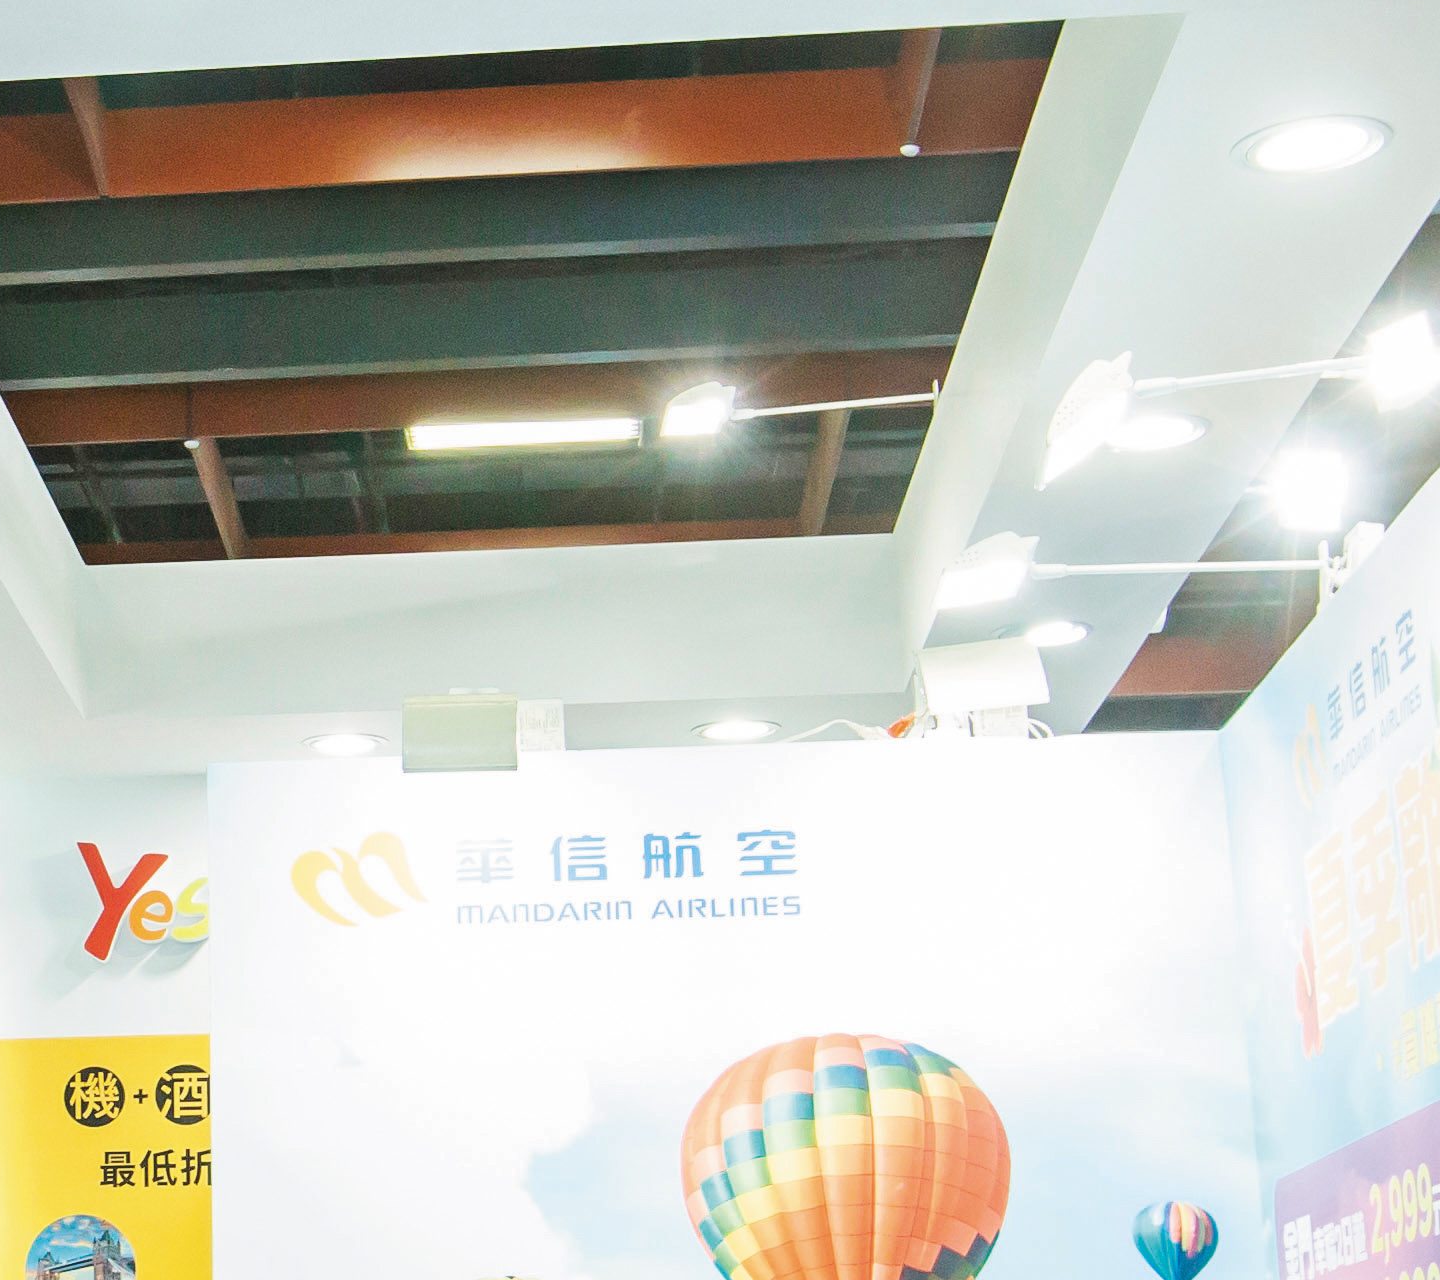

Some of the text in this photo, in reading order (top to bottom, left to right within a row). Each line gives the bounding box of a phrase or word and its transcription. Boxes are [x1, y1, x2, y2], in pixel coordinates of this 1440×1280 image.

[1326, 607, 1417, 742] 華信航空
[455, 829, 799, 884] 華信航空
[456, 896, 801, 924] MANDARIN AIRLINES
